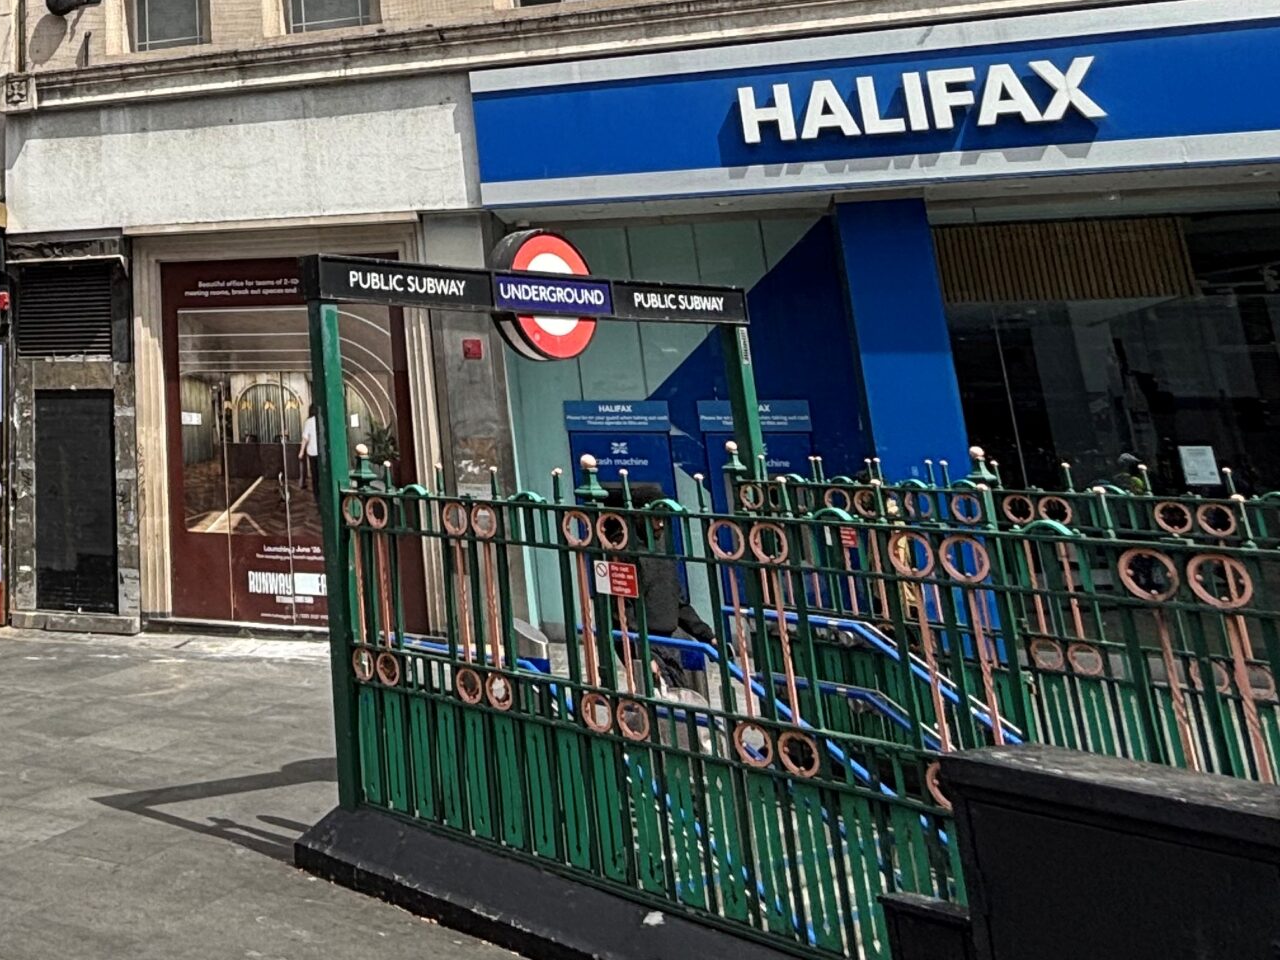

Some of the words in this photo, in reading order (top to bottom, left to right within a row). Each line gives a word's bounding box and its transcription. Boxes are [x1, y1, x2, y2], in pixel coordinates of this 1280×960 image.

[737, 55, 1108, 144] HALIFAX
[349, 270, 403, 292] PUBLIC
[406, 274, 465, 297] SUBWAY
[499, 283, 605, 306] UNDERGROUND
[633, 293, 677, 310] PUBLIC
[677, 294, 724, 312] SUBWAY
[598, 405, 632, 413] HALIFAX
[597, 457, 612, 466] cash
[614, 457, 649, 466] machine
[766, 459, 790, 467] chine
[248, 570, 292, 596] RUNWAY
